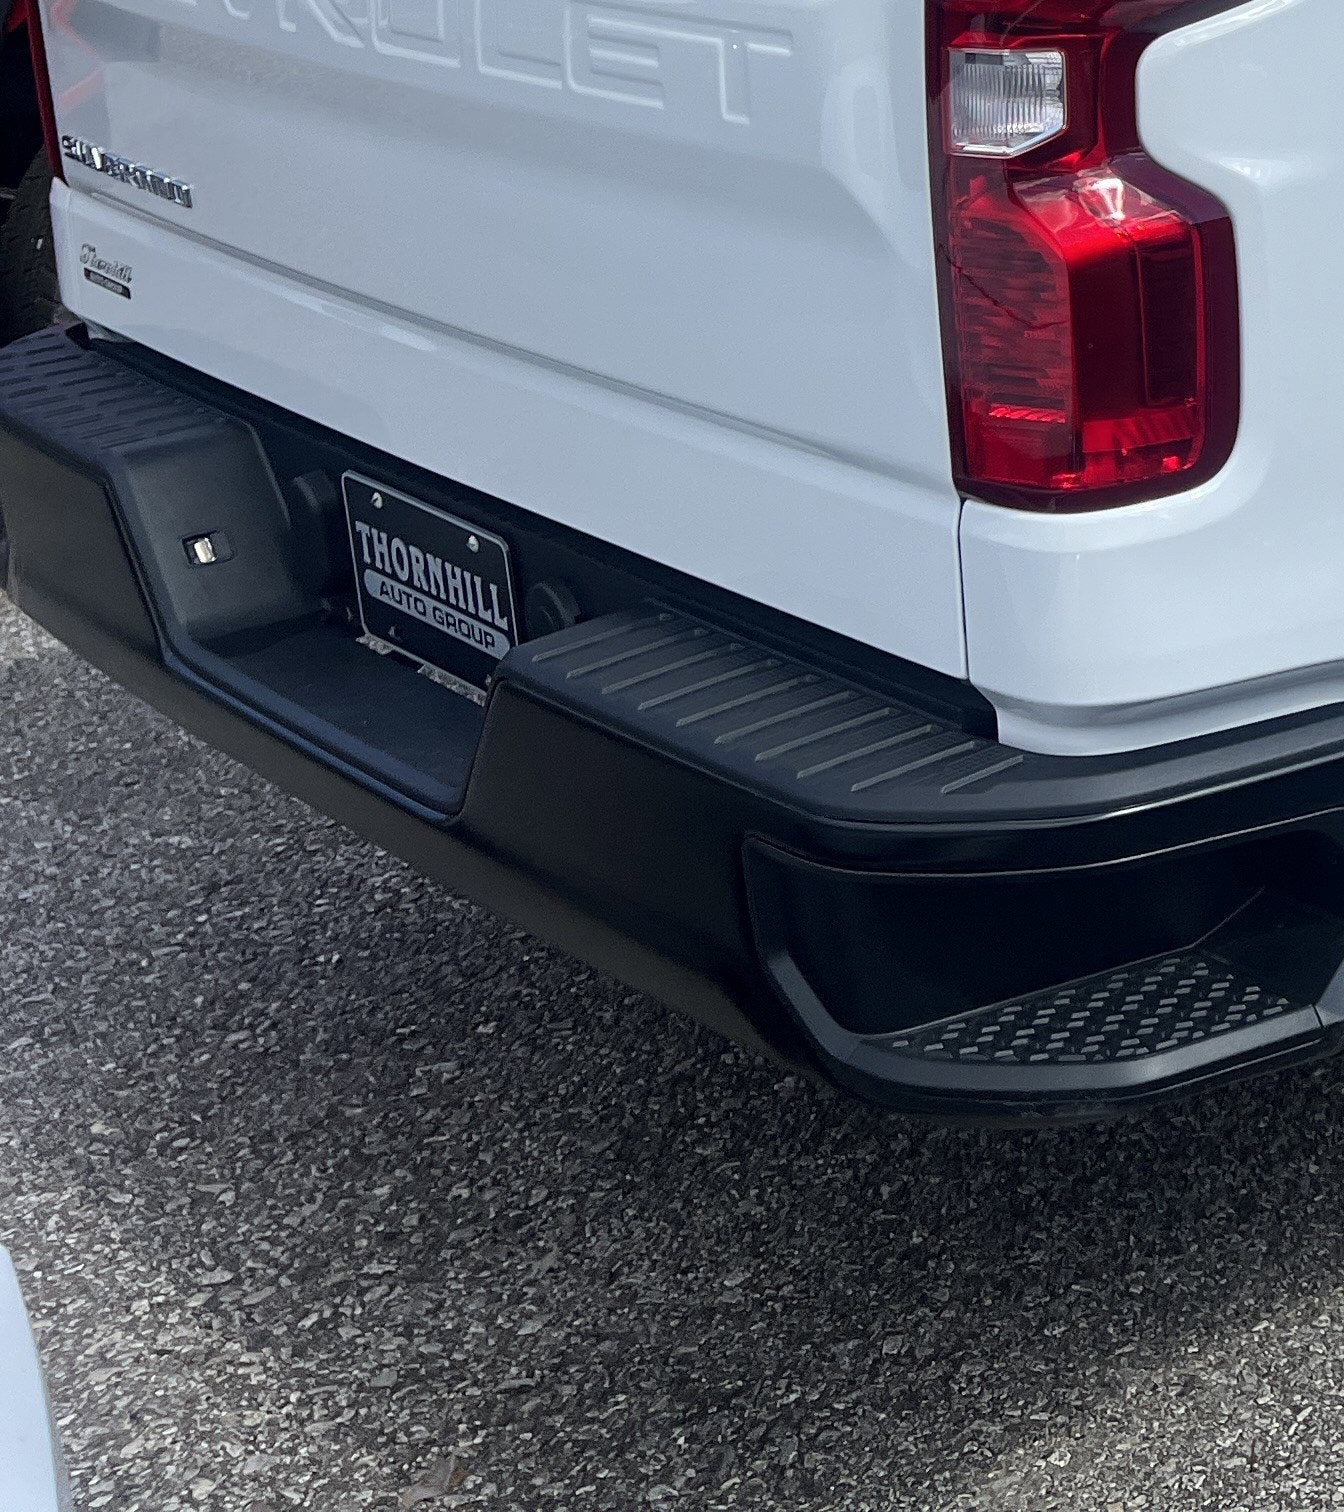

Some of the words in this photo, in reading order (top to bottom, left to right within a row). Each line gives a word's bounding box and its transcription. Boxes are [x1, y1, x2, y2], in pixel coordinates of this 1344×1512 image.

[355, 520, 508, 631] THORNHILL
[378, 579, 428, 617] AUTO
[431, 605, 497, 650] GROUP
